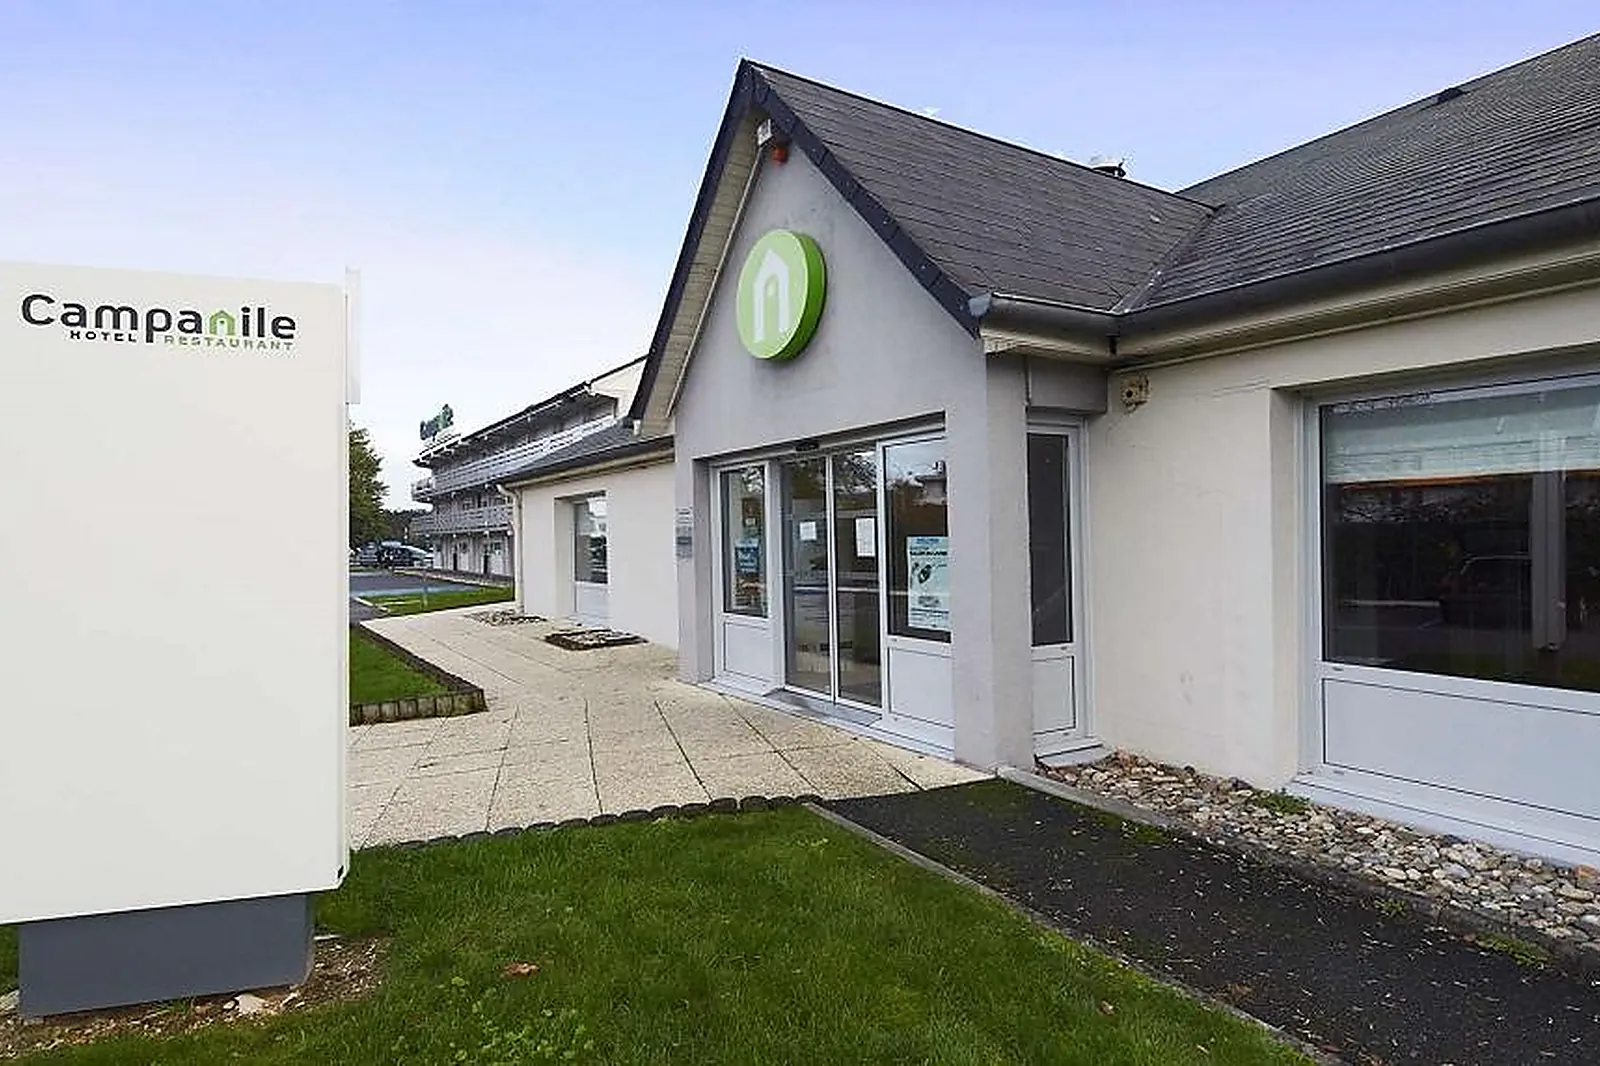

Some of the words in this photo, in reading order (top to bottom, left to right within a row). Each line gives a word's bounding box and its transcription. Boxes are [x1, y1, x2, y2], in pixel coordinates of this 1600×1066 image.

[21, 294, 296, 343] Campanile
[70, 329, 138, 343] HOTEL
[164, 335, 295, 351] RESTAURANT
